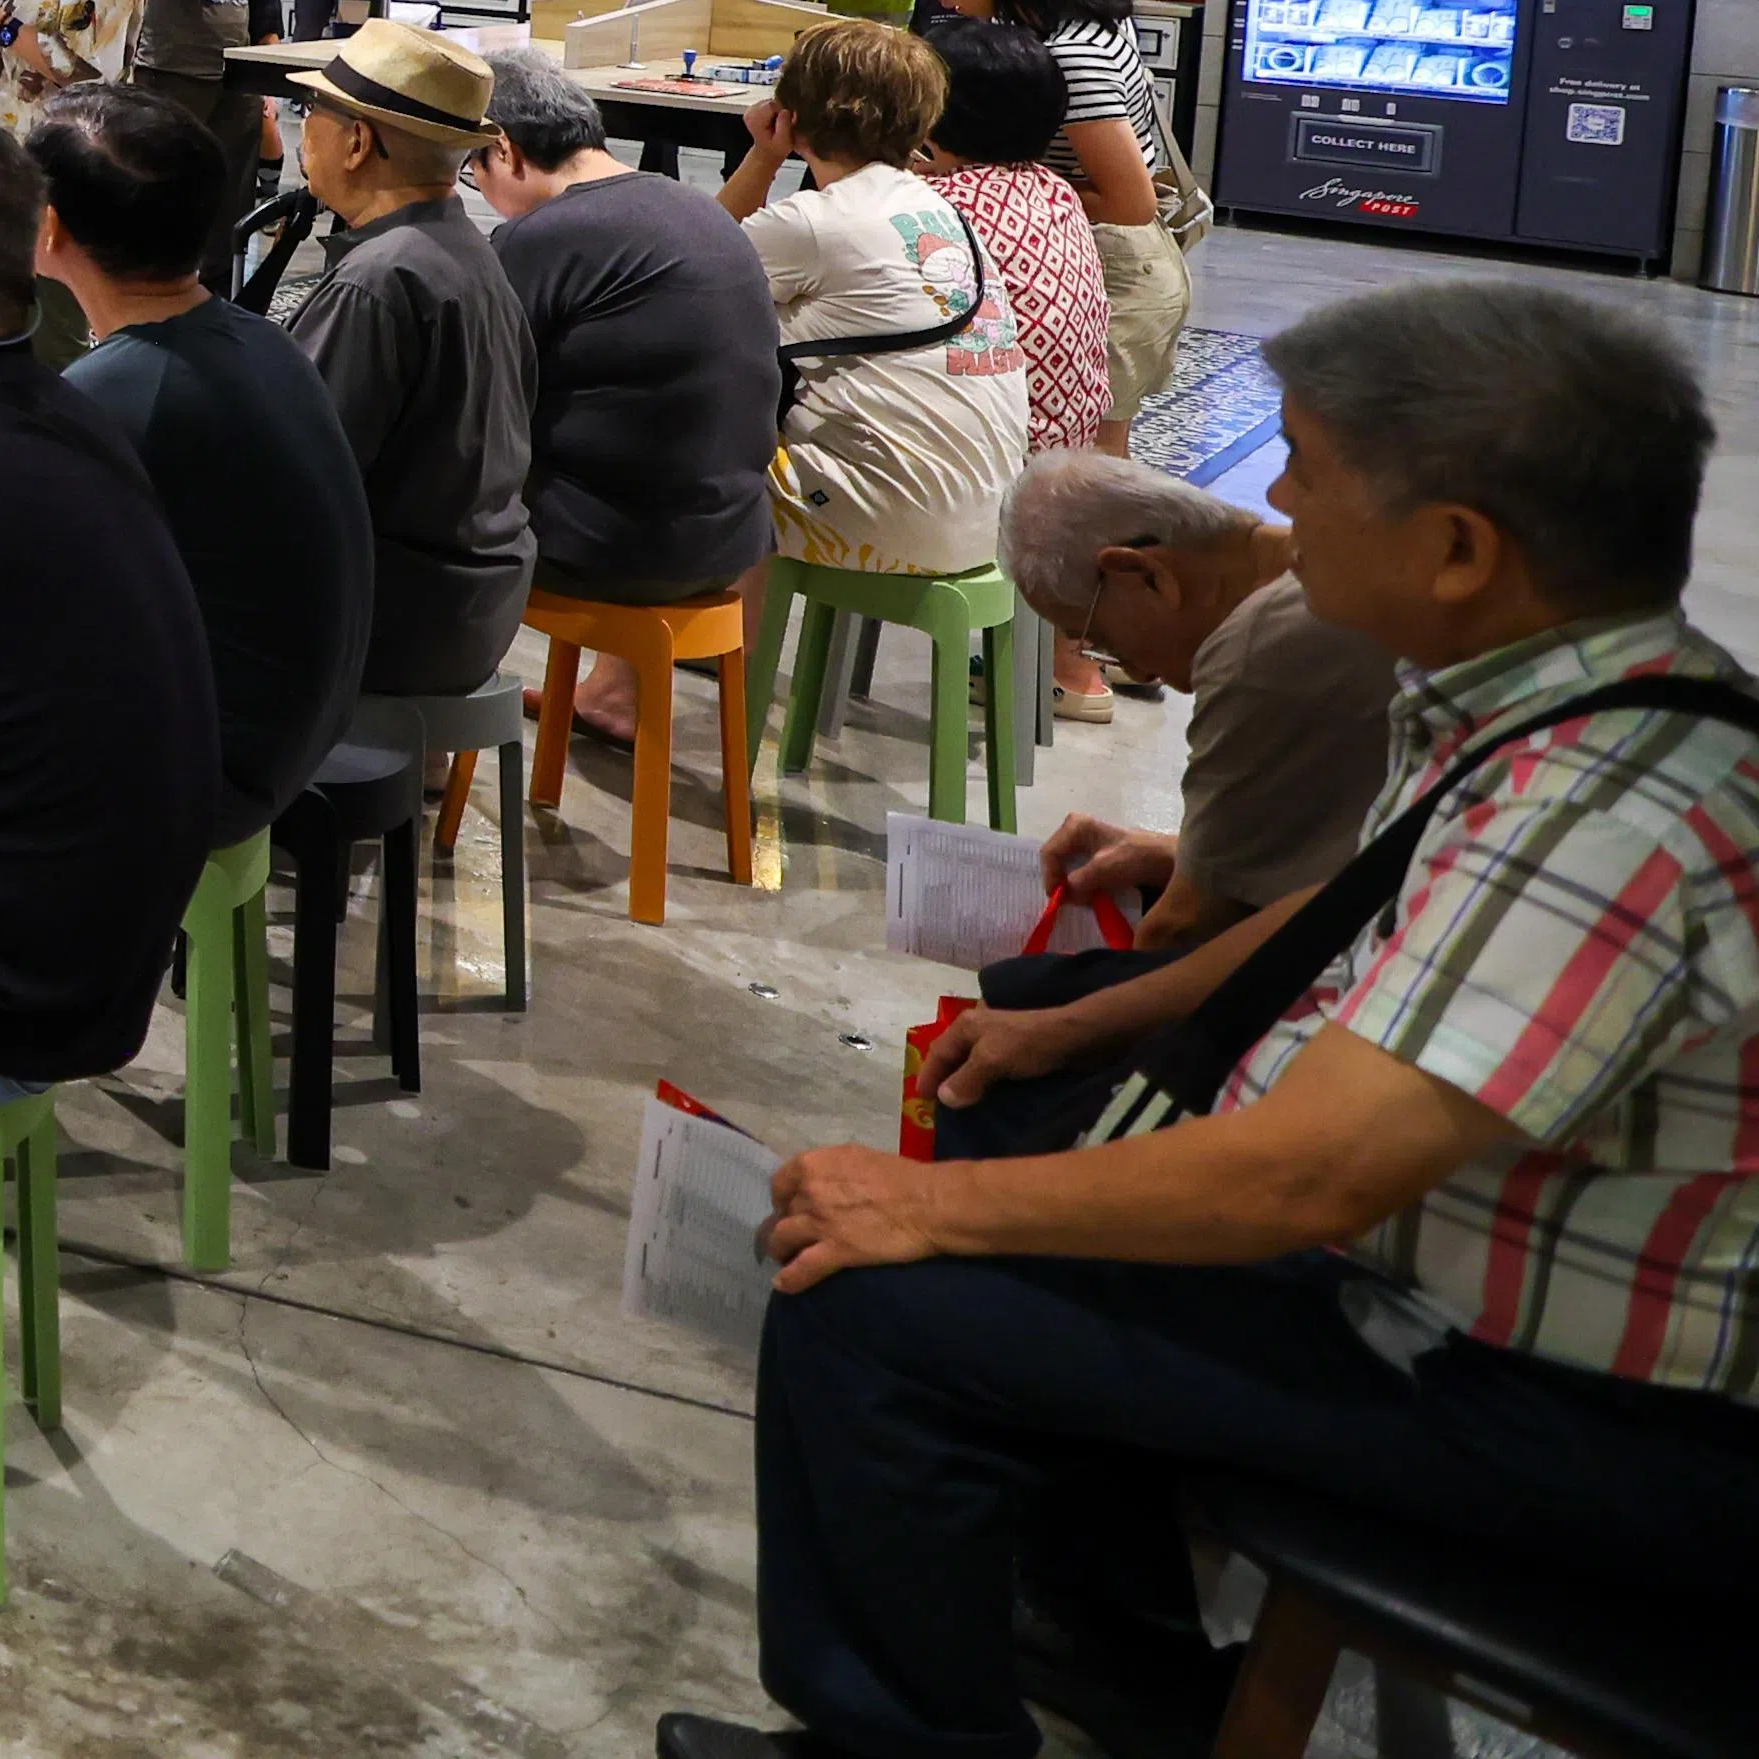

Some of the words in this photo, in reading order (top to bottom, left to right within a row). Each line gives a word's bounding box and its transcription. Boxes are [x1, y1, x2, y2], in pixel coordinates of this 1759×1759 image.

[1311, 134, 1375, 150] COLLECT
[1378, 142, 1416, 154] HERE
[1298, 177, 1420, 207] Singapore
[1371, 202, 1412, 216] POST
